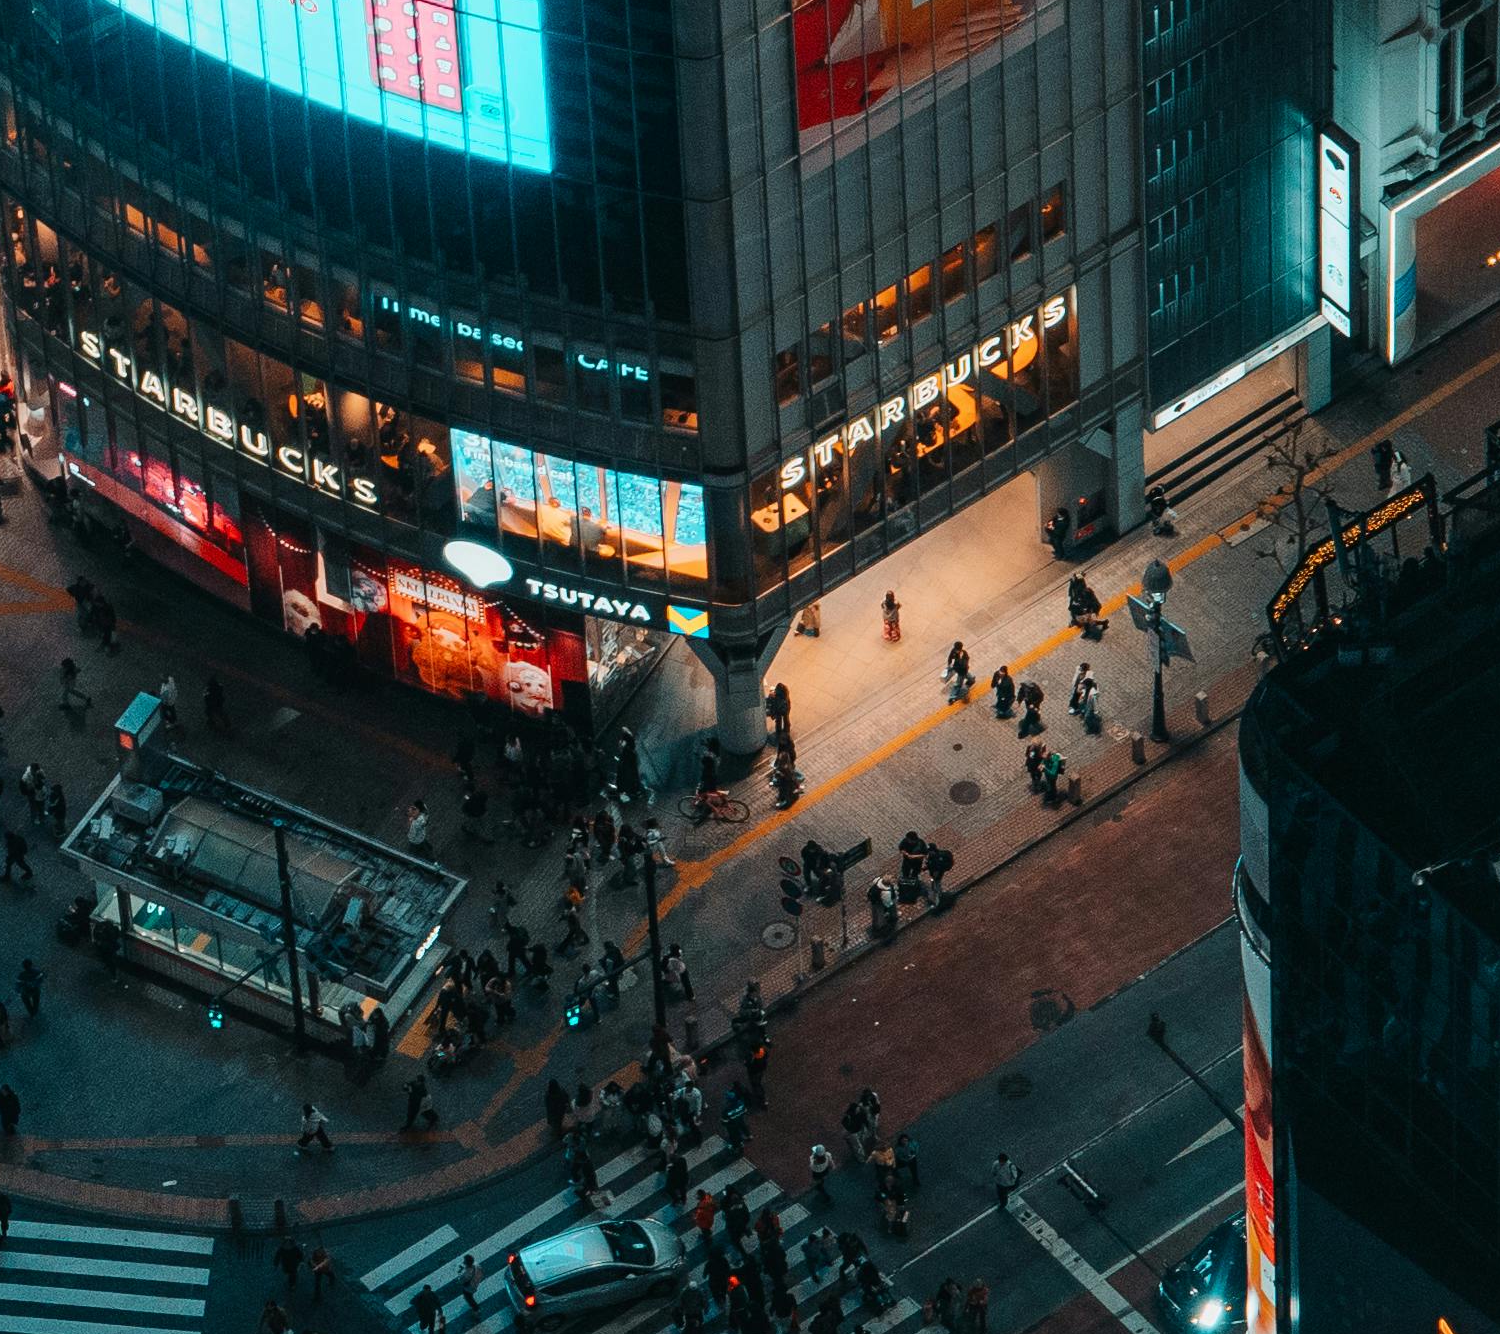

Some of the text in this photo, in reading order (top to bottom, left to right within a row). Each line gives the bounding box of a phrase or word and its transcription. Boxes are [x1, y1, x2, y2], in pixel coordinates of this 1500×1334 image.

[80, 328, 380, 507] STARBUCKS
[783, 293, 1068, 490] STARBUCKS
[525, 577, 651, 622] TSUTAYA
